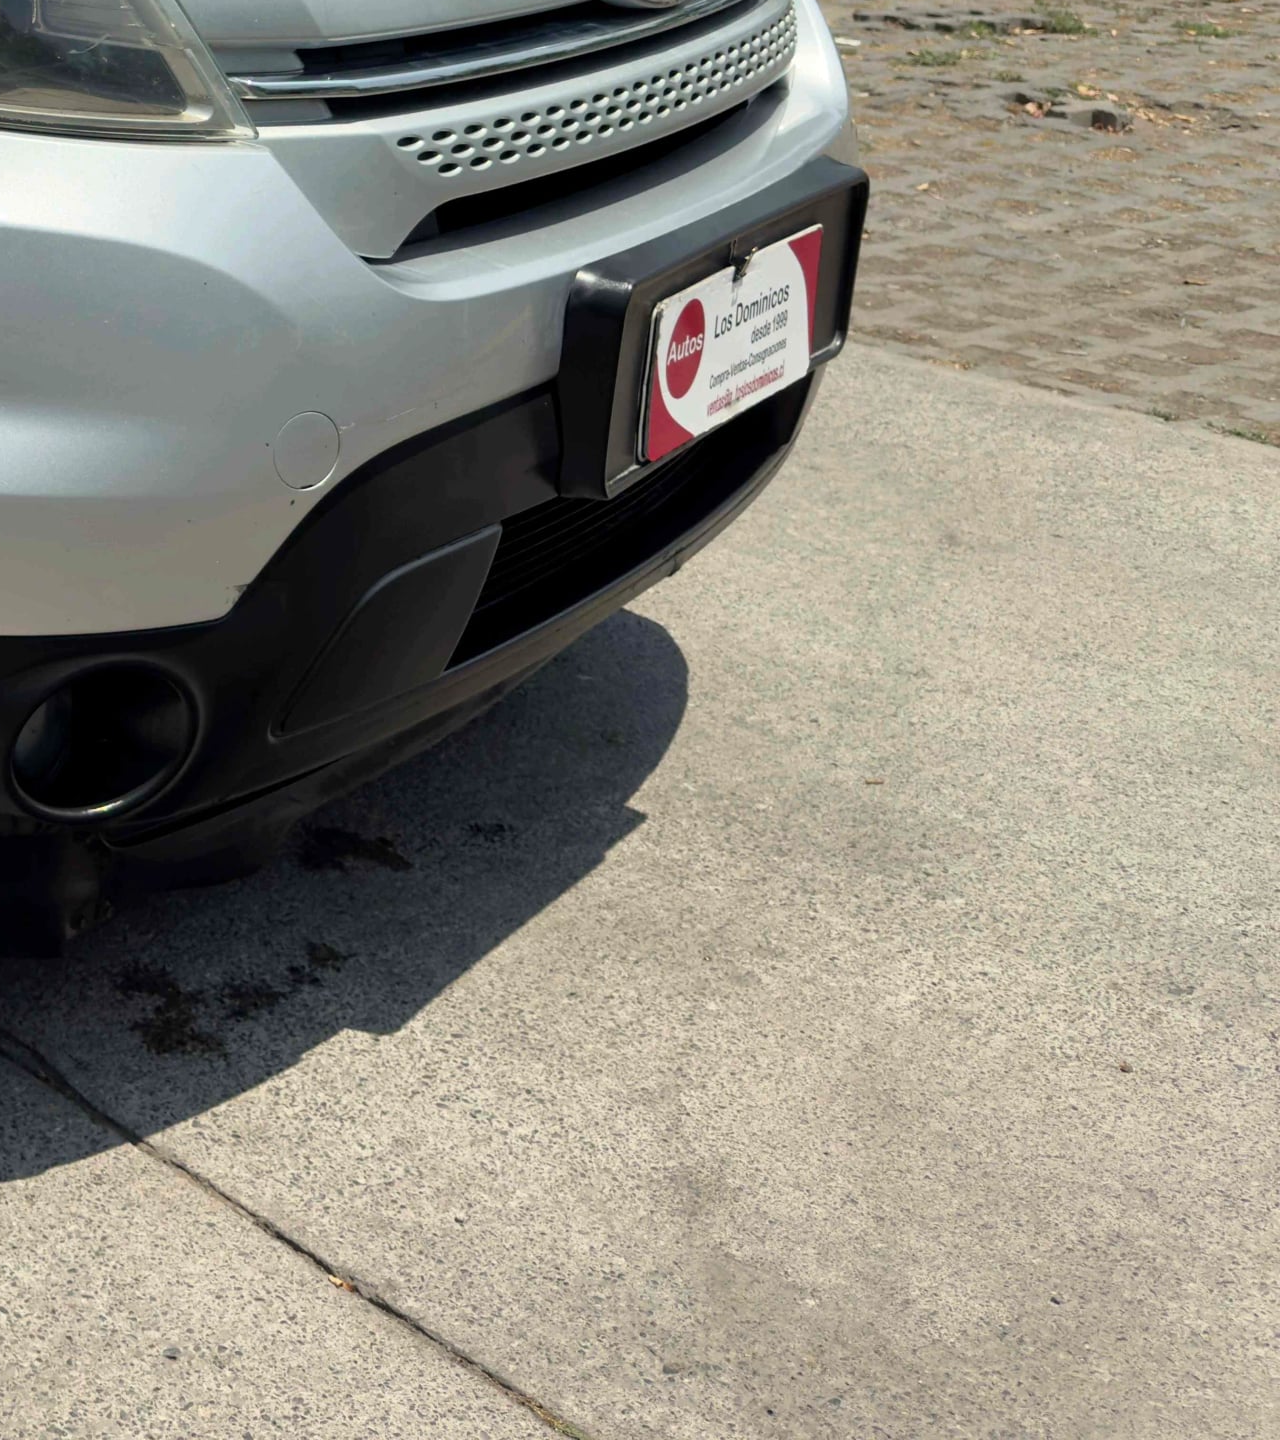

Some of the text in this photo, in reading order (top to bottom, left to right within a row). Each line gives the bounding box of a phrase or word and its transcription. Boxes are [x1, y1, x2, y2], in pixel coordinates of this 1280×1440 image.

[714, 284, 790, 339] Los Dominicos
[750, 309, 788, 344] desde 1999
[667, 332, 704, 366] Autos
